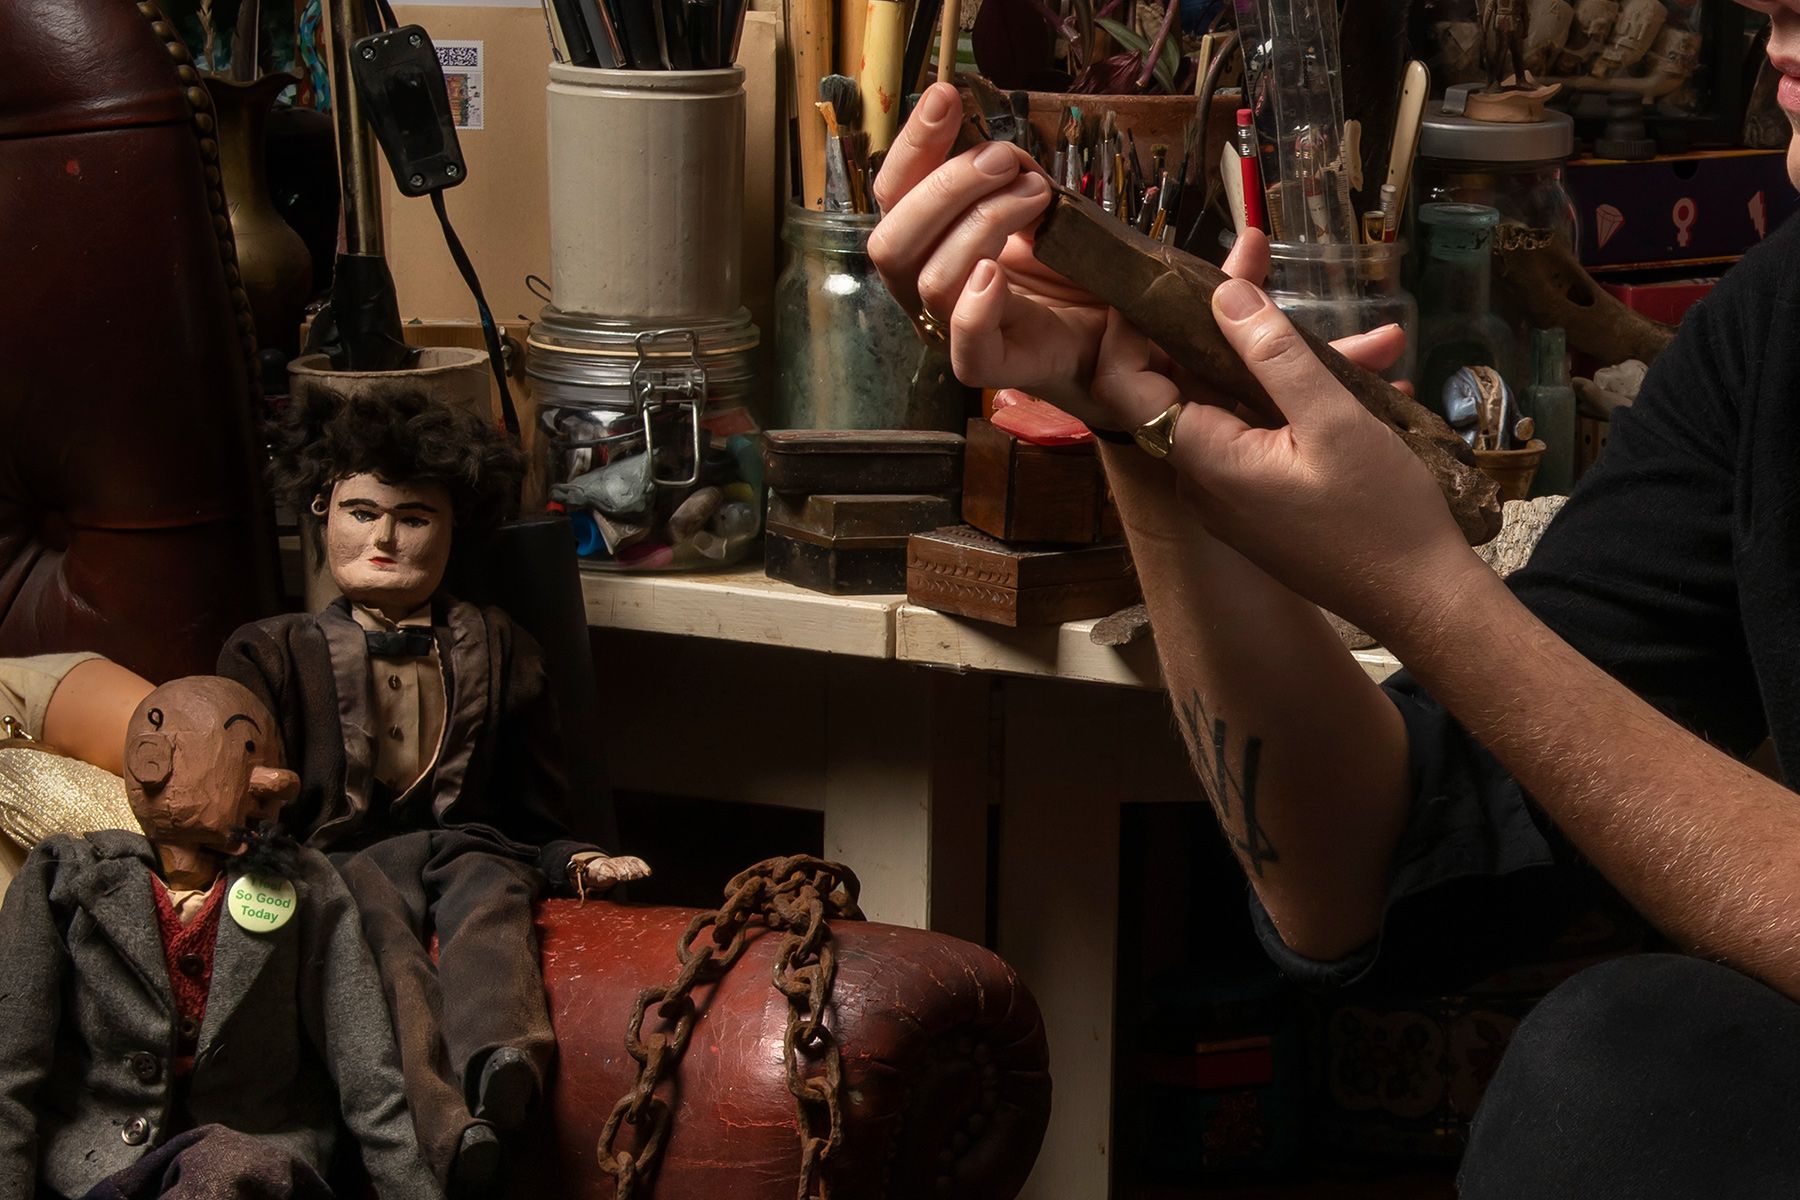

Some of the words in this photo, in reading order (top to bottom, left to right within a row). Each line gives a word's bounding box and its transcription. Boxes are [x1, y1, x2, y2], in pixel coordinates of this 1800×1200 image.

[235, 889, 253, 901] So
[256, 893, 292, 909] Good
[241, 905, 279, 924] Today
